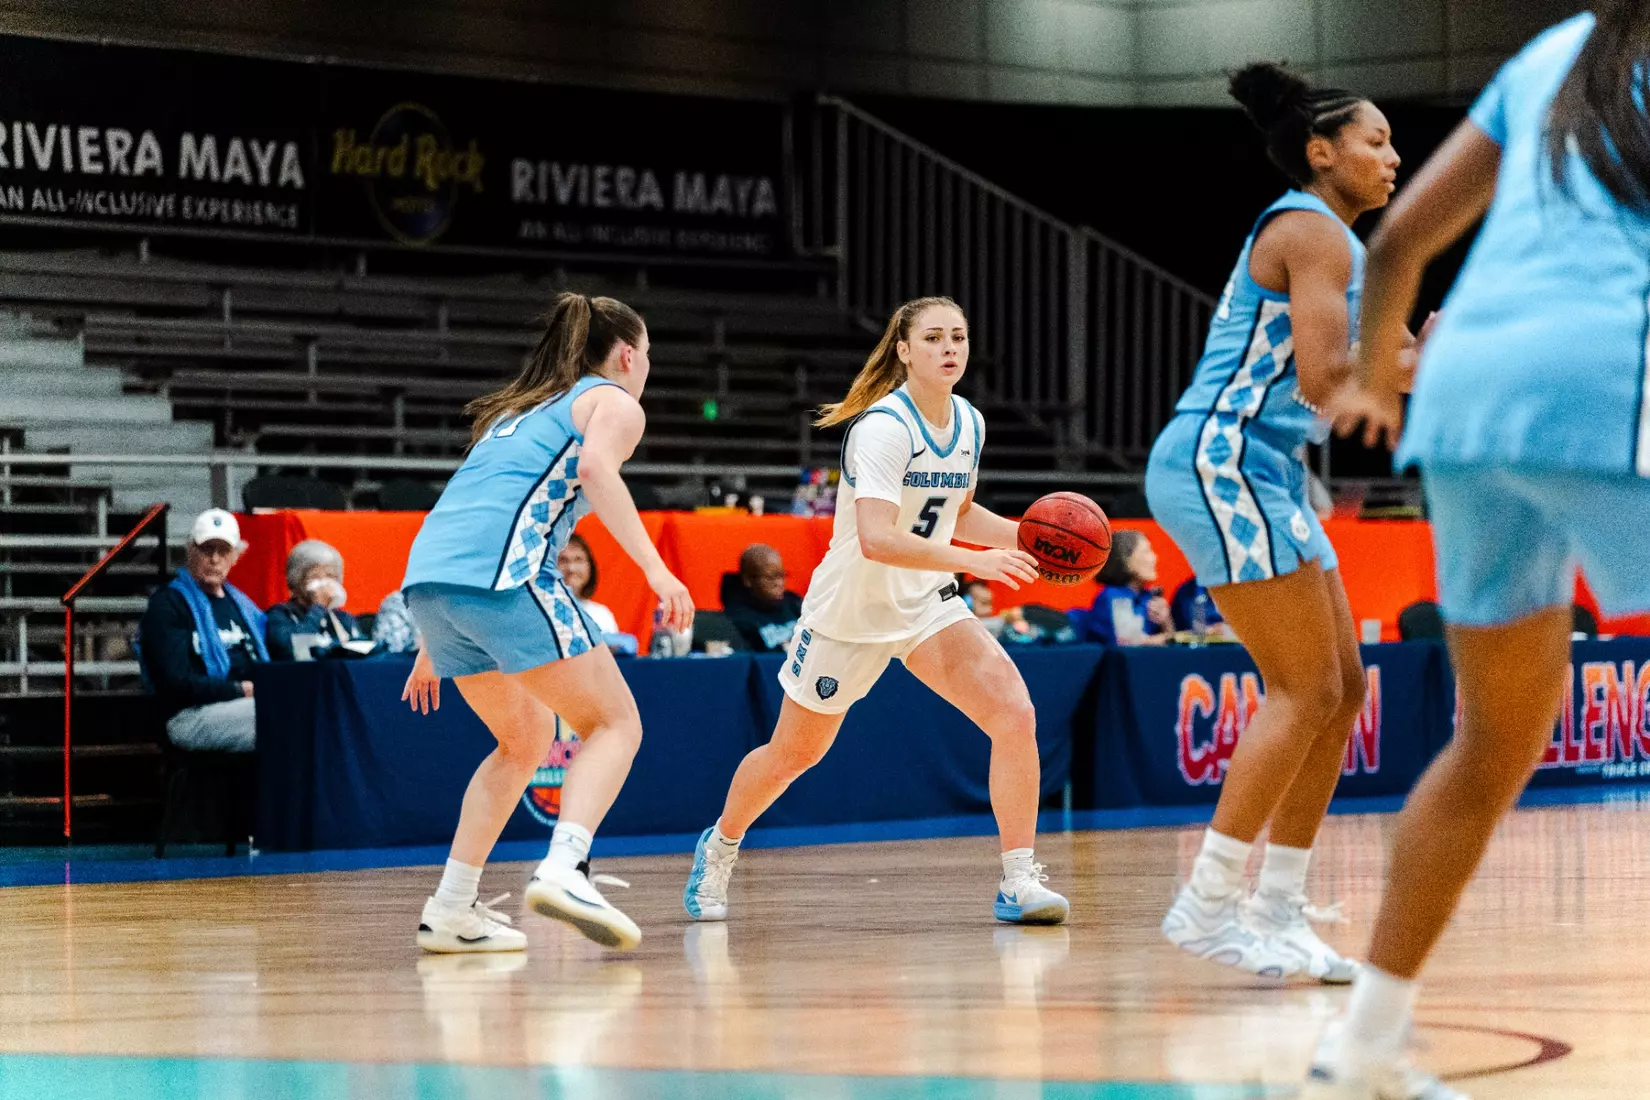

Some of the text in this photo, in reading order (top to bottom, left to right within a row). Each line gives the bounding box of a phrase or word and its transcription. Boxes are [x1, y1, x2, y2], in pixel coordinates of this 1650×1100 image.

[178, 132, 305, 189] MAYA
[330, 128, 410, 176] Hard
[31, 187, 177, 219] ALL-INCLUSIVE
[181, 195, 299, 229] EXPERIENCE
[509, 156, 777, 218] RIVIERA MAYA
[910, 496, 949, 538] 5
[1033, 535, 1083, 564] NCAA
[791, 627, 814, 678] ONS
[1174, 663, 1381, 786] CAN
